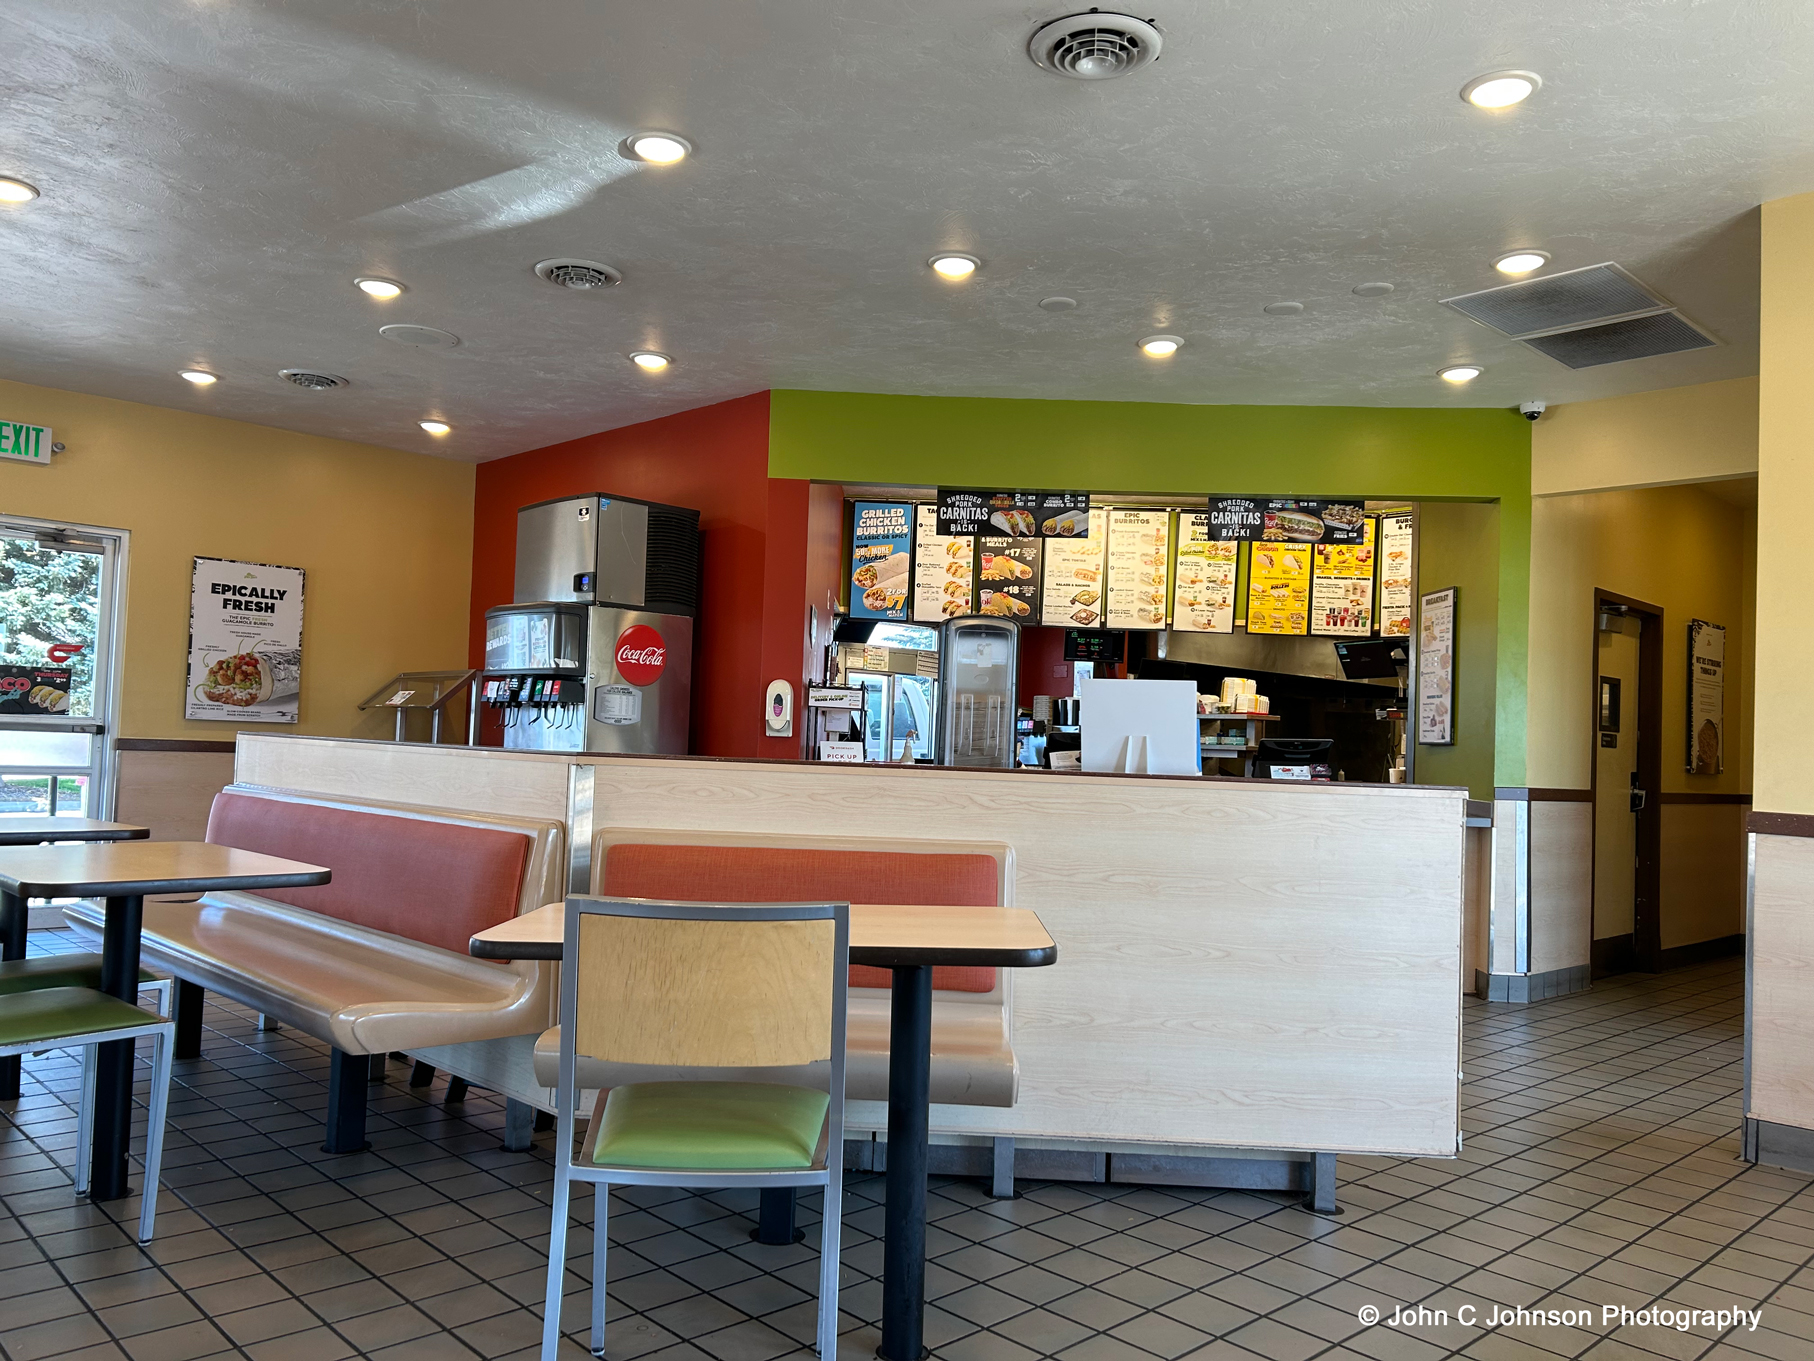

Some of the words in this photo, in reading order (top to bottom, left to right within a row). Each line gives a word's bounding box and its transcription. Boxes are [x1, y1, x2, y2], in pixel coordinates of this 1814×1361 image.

[0, 422, 44, 458] EXIT
[946, 494, 982, 504] SHREDDED
[1218, 499, 1254, 508] SHREDDED
[862, 508, 904, 518] GRILLED
[940, 507, 988, 520] CARNITAS
[1211, 512, 1261, 524] CARNITAS
[859, 517, 905, 526] CHICKEN
[856, 525, 908, 535] BURRITOS
[872, 546, 889, 554] MORE
[1005, 548, 1021, 557] #17
[859, 554, 888, 563] Chicken
[211, 583, 287, 600] EPICALLY
[1003, 586, 1019, 594] #18
[223, 598, 275, 613] FRESH
[886, 596, 906, 609] $7
[487, 634, 511, 651] REWARDS
[618, 645, 666, 665] Coca-Cola
